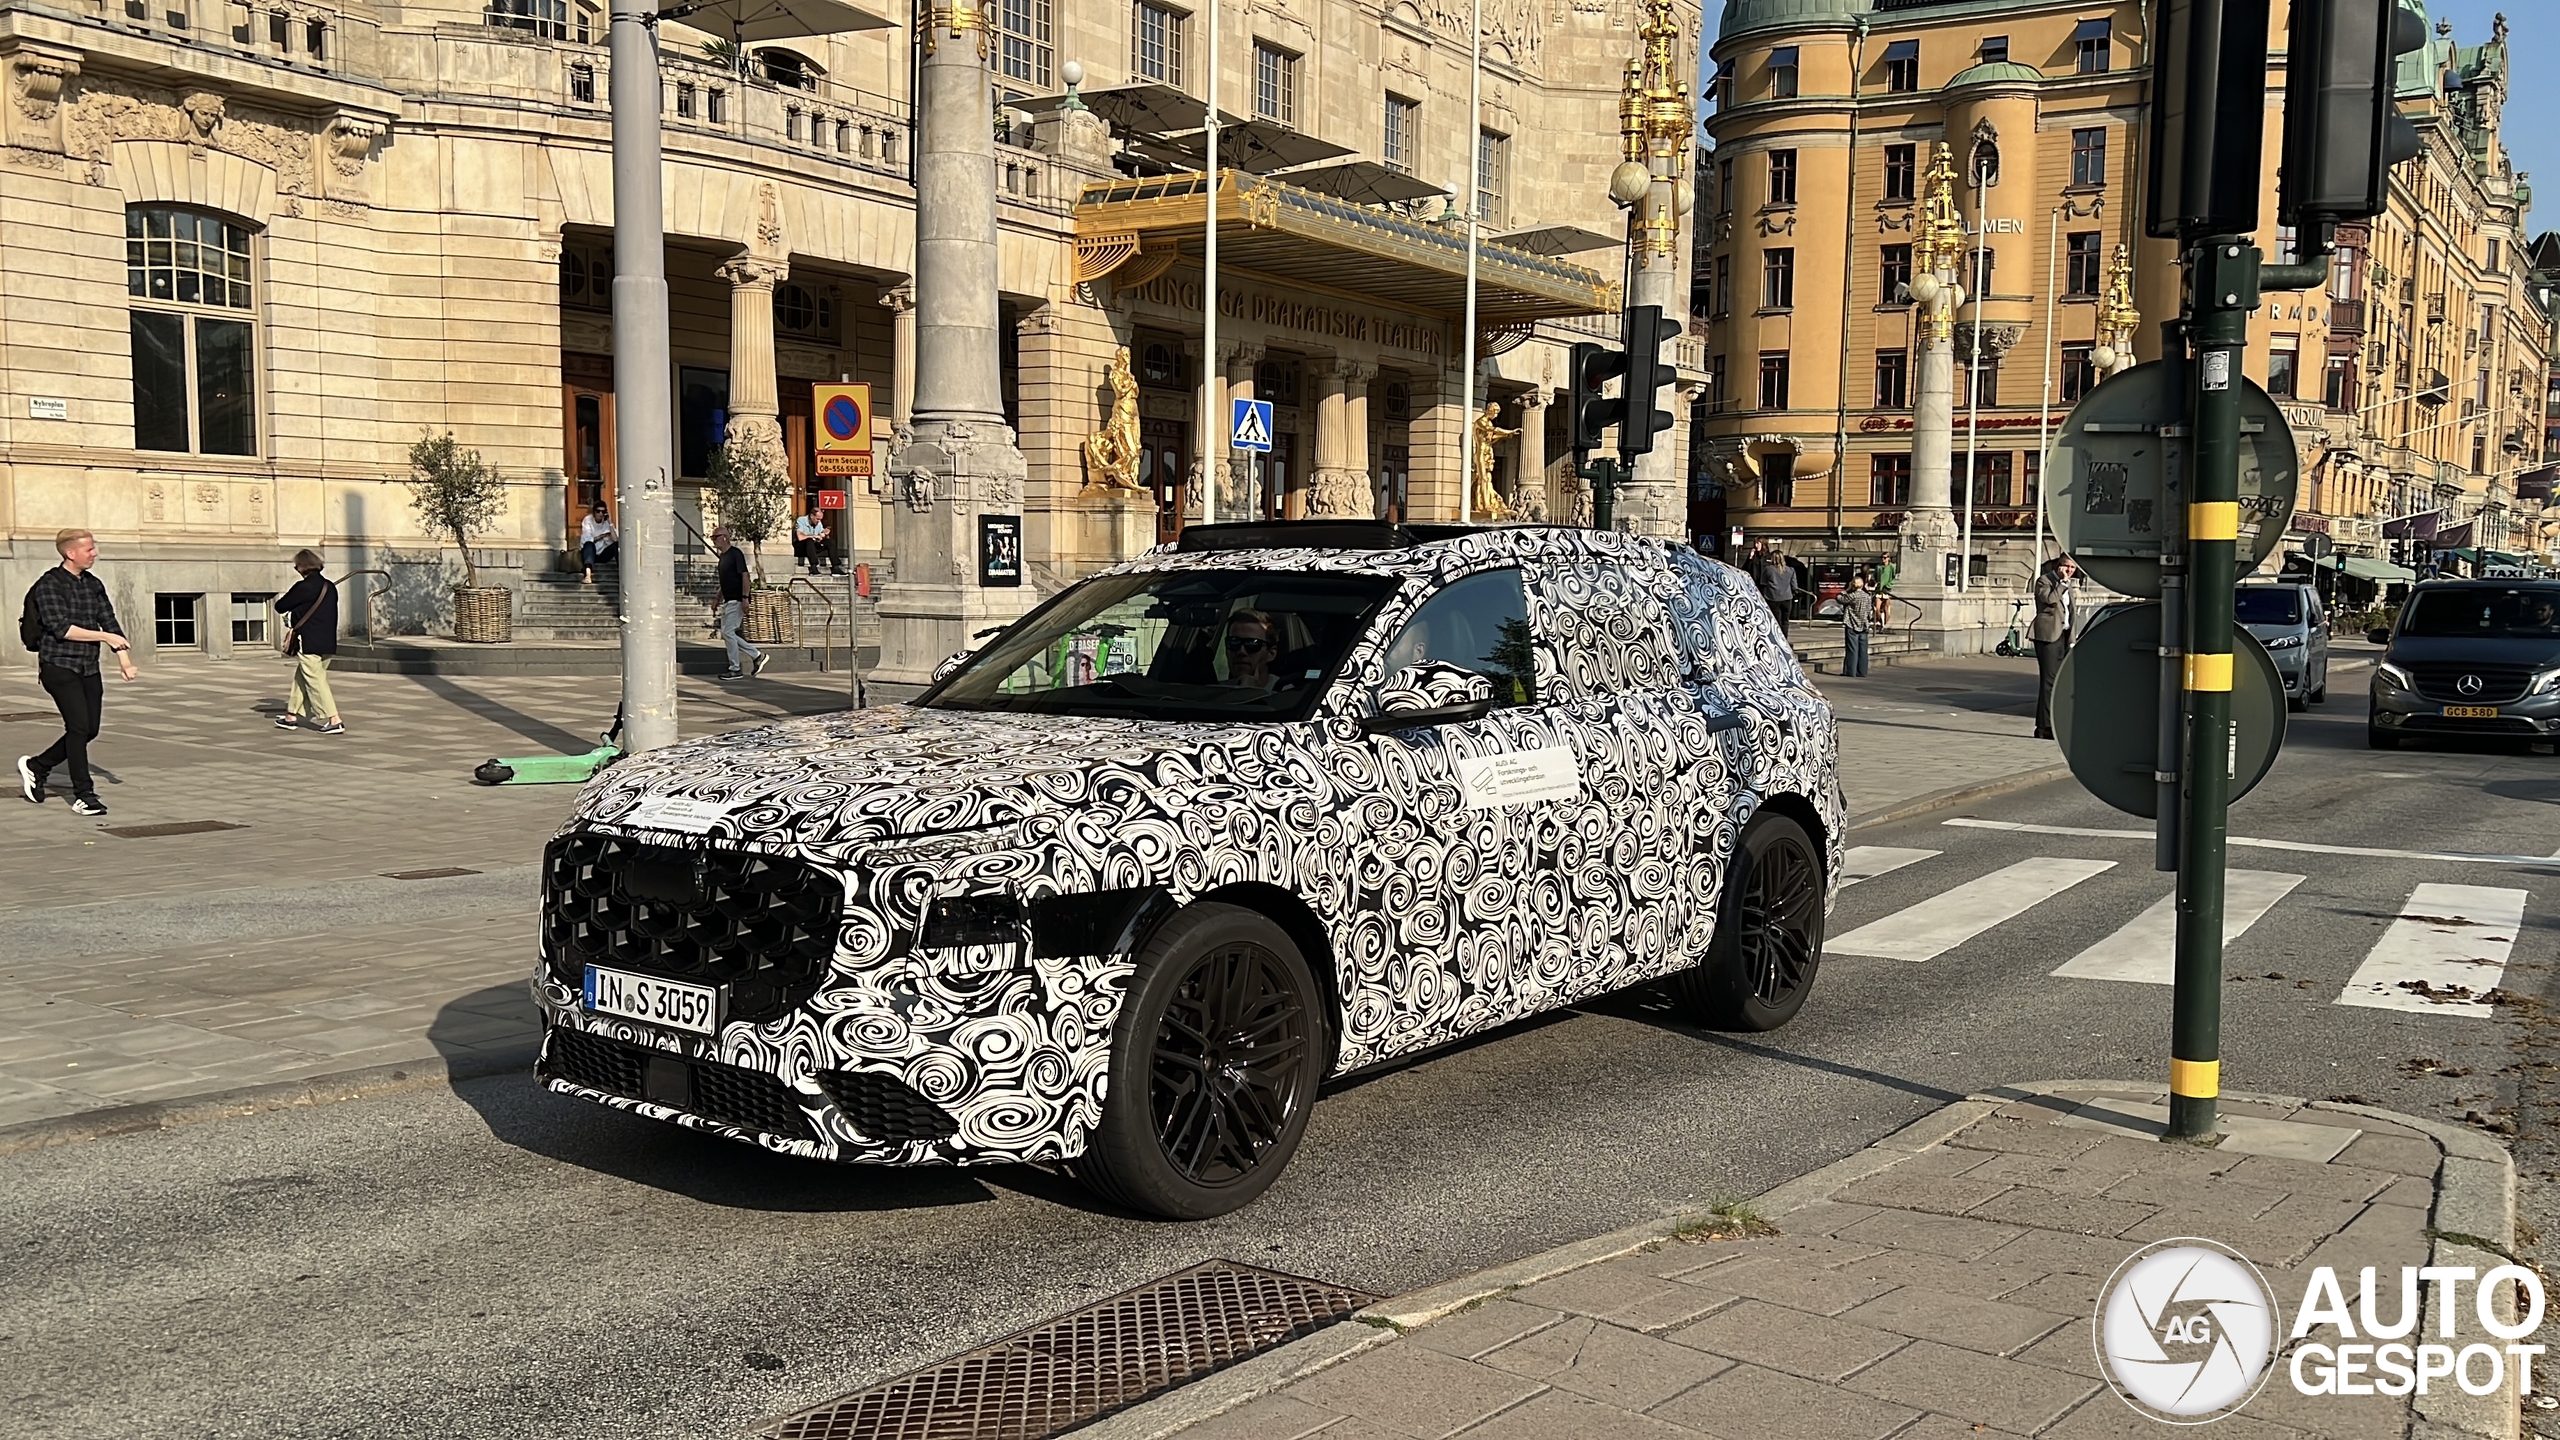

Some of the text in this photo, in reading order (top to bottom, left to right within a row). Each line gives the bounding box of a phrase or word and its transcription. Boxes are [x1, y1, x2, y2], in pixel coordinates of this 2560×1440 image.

[1961, 218, 2024, 236] LMEN
[1134, 277, 1441, 356] KUNGGA DRAMATISKA TEATERN
[819, 456, 869, 465] Avarn Security
[2488, 569, 2524, 578] TAXI
[2446, 707, 2493, 717] GCB 58D
[598, 974, 622, 1010] IN
